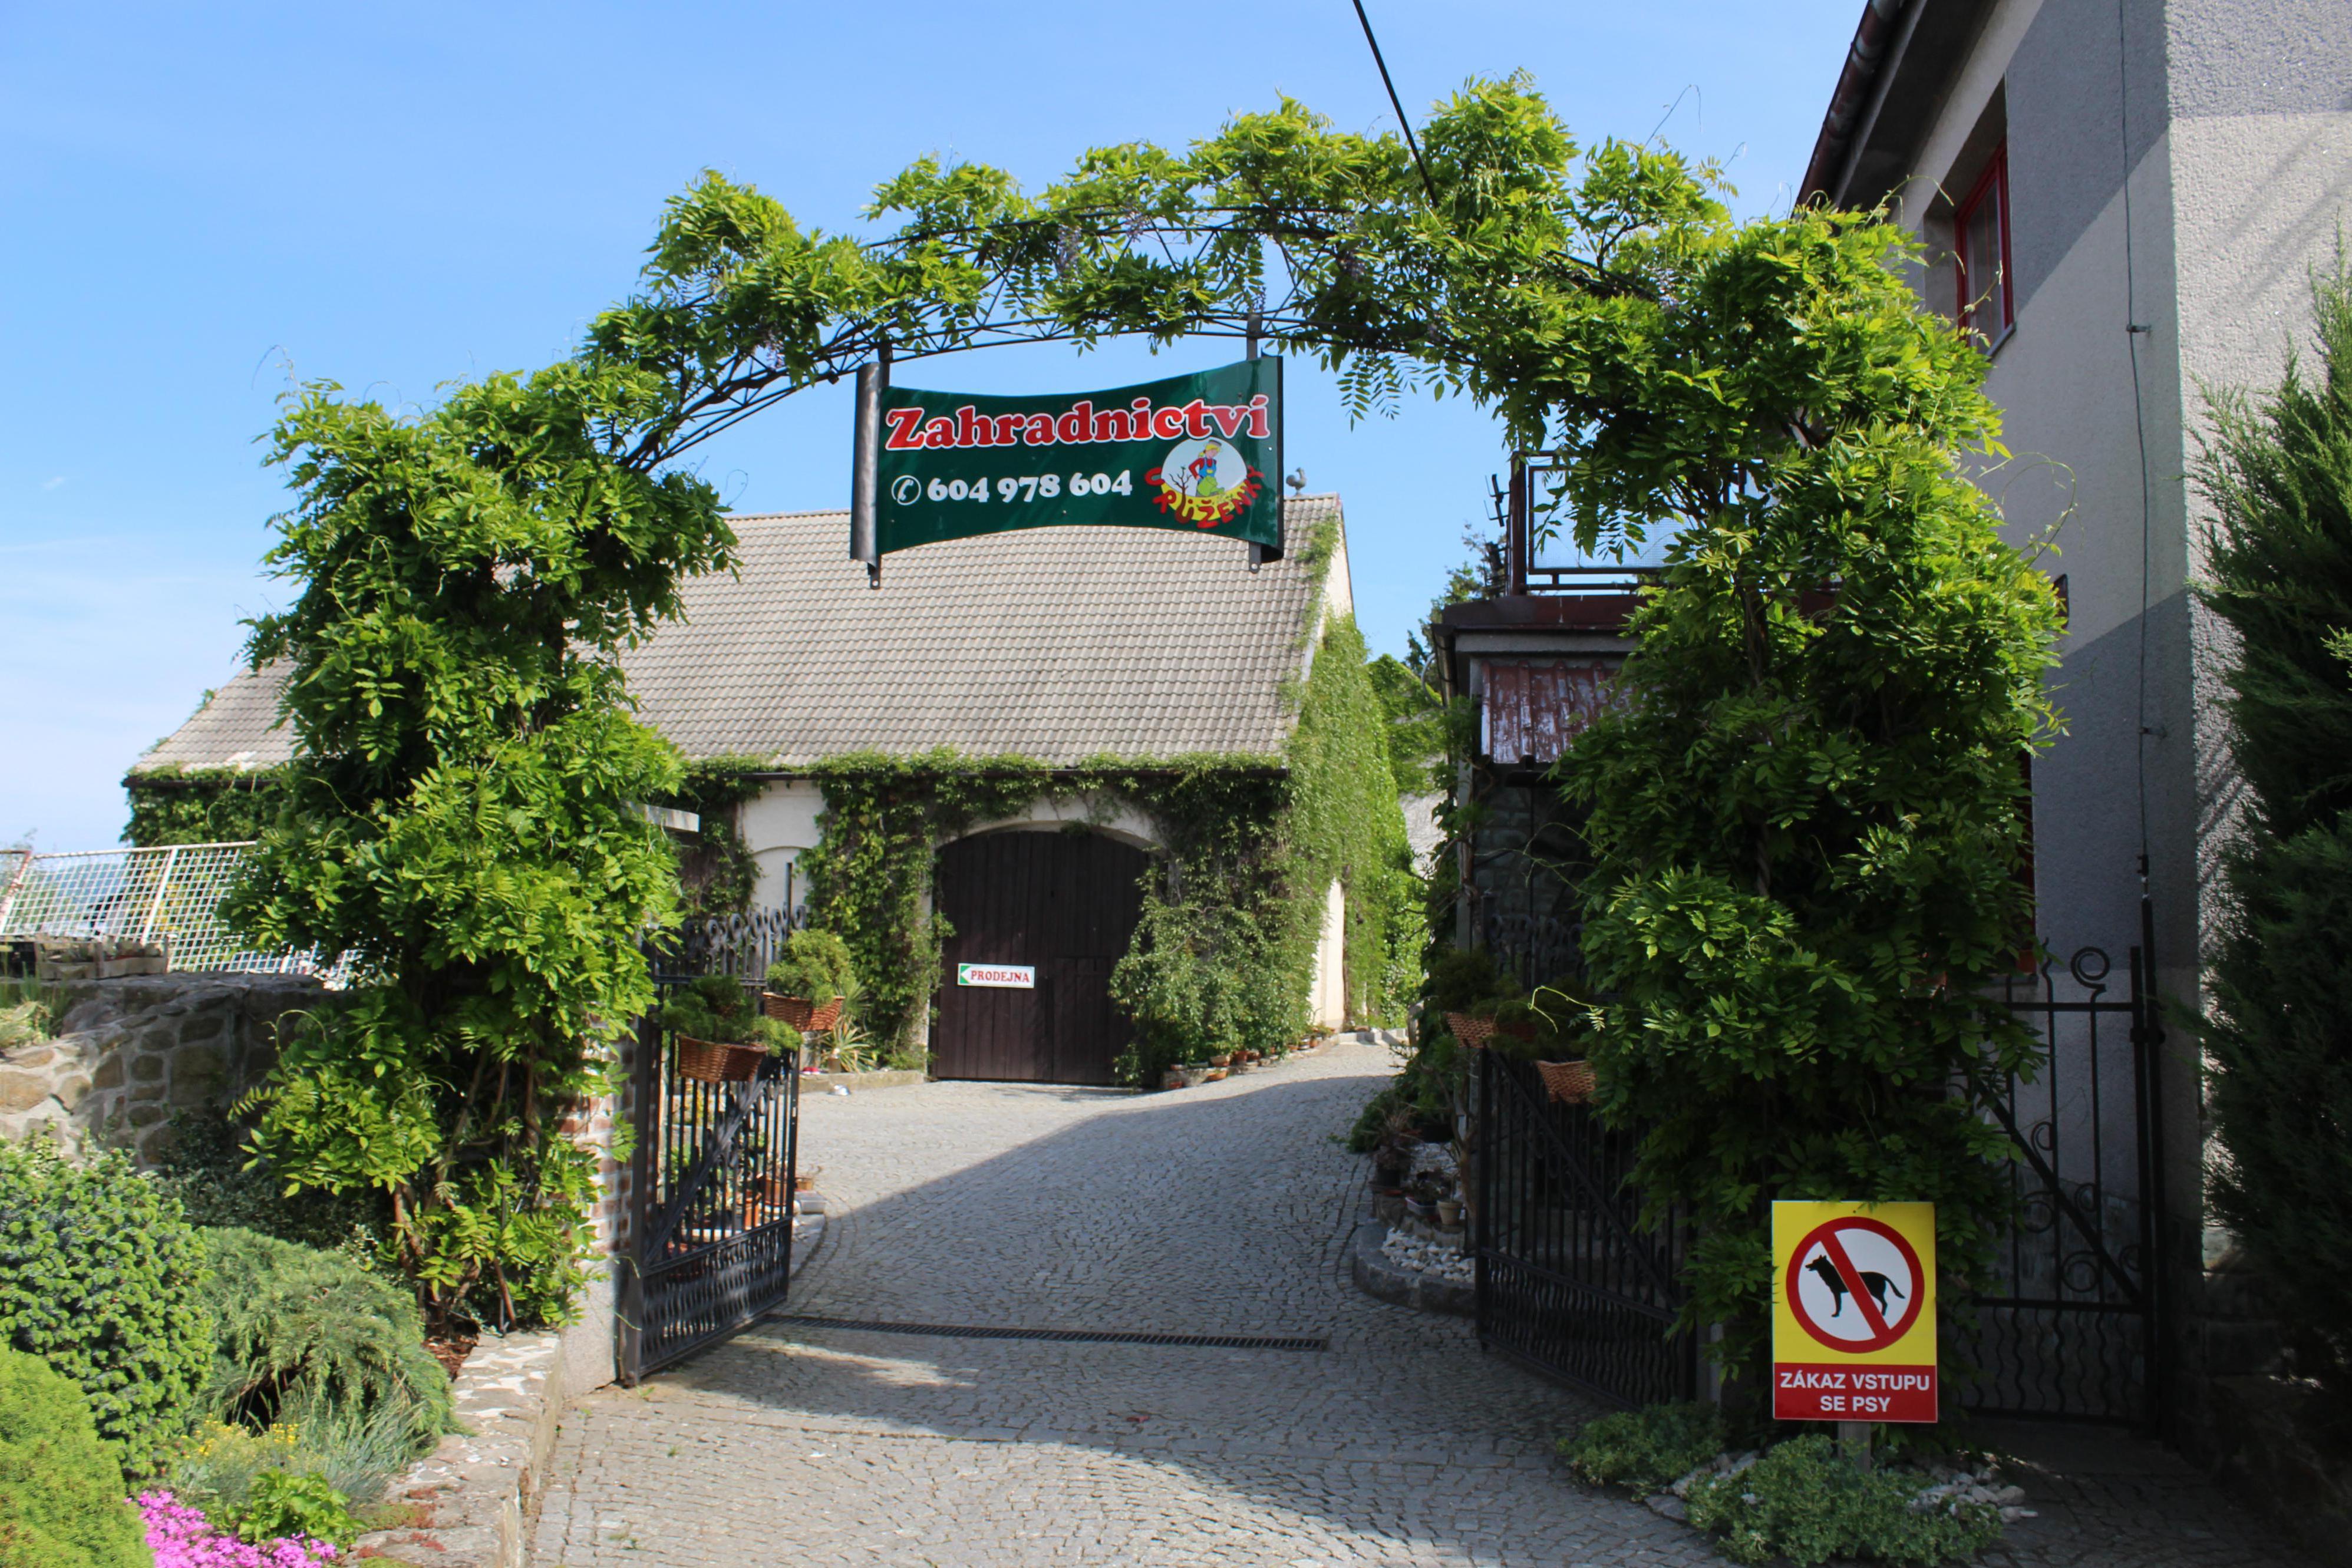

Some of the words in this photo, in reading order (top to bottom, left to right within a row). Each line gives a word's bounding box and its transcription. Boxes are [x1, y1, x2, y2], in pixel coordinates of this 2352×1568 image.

[885, 394, 1270, 450] Zahradnictví
[927, 477, 989, 503] 604
[997, 474, 1061, 503] 978
[1069, 470, 1133, 496] 604
[970, 970, 1030, 983] PRODEJNA
[1780, 1370, 1846, 1389] ZÁKAZ
[1852, 1374, 1930, 1391] VSTUPU
[1820, 1395, 1846, 1411] SE
[1852, 1396, 1891, 1412] PSY
